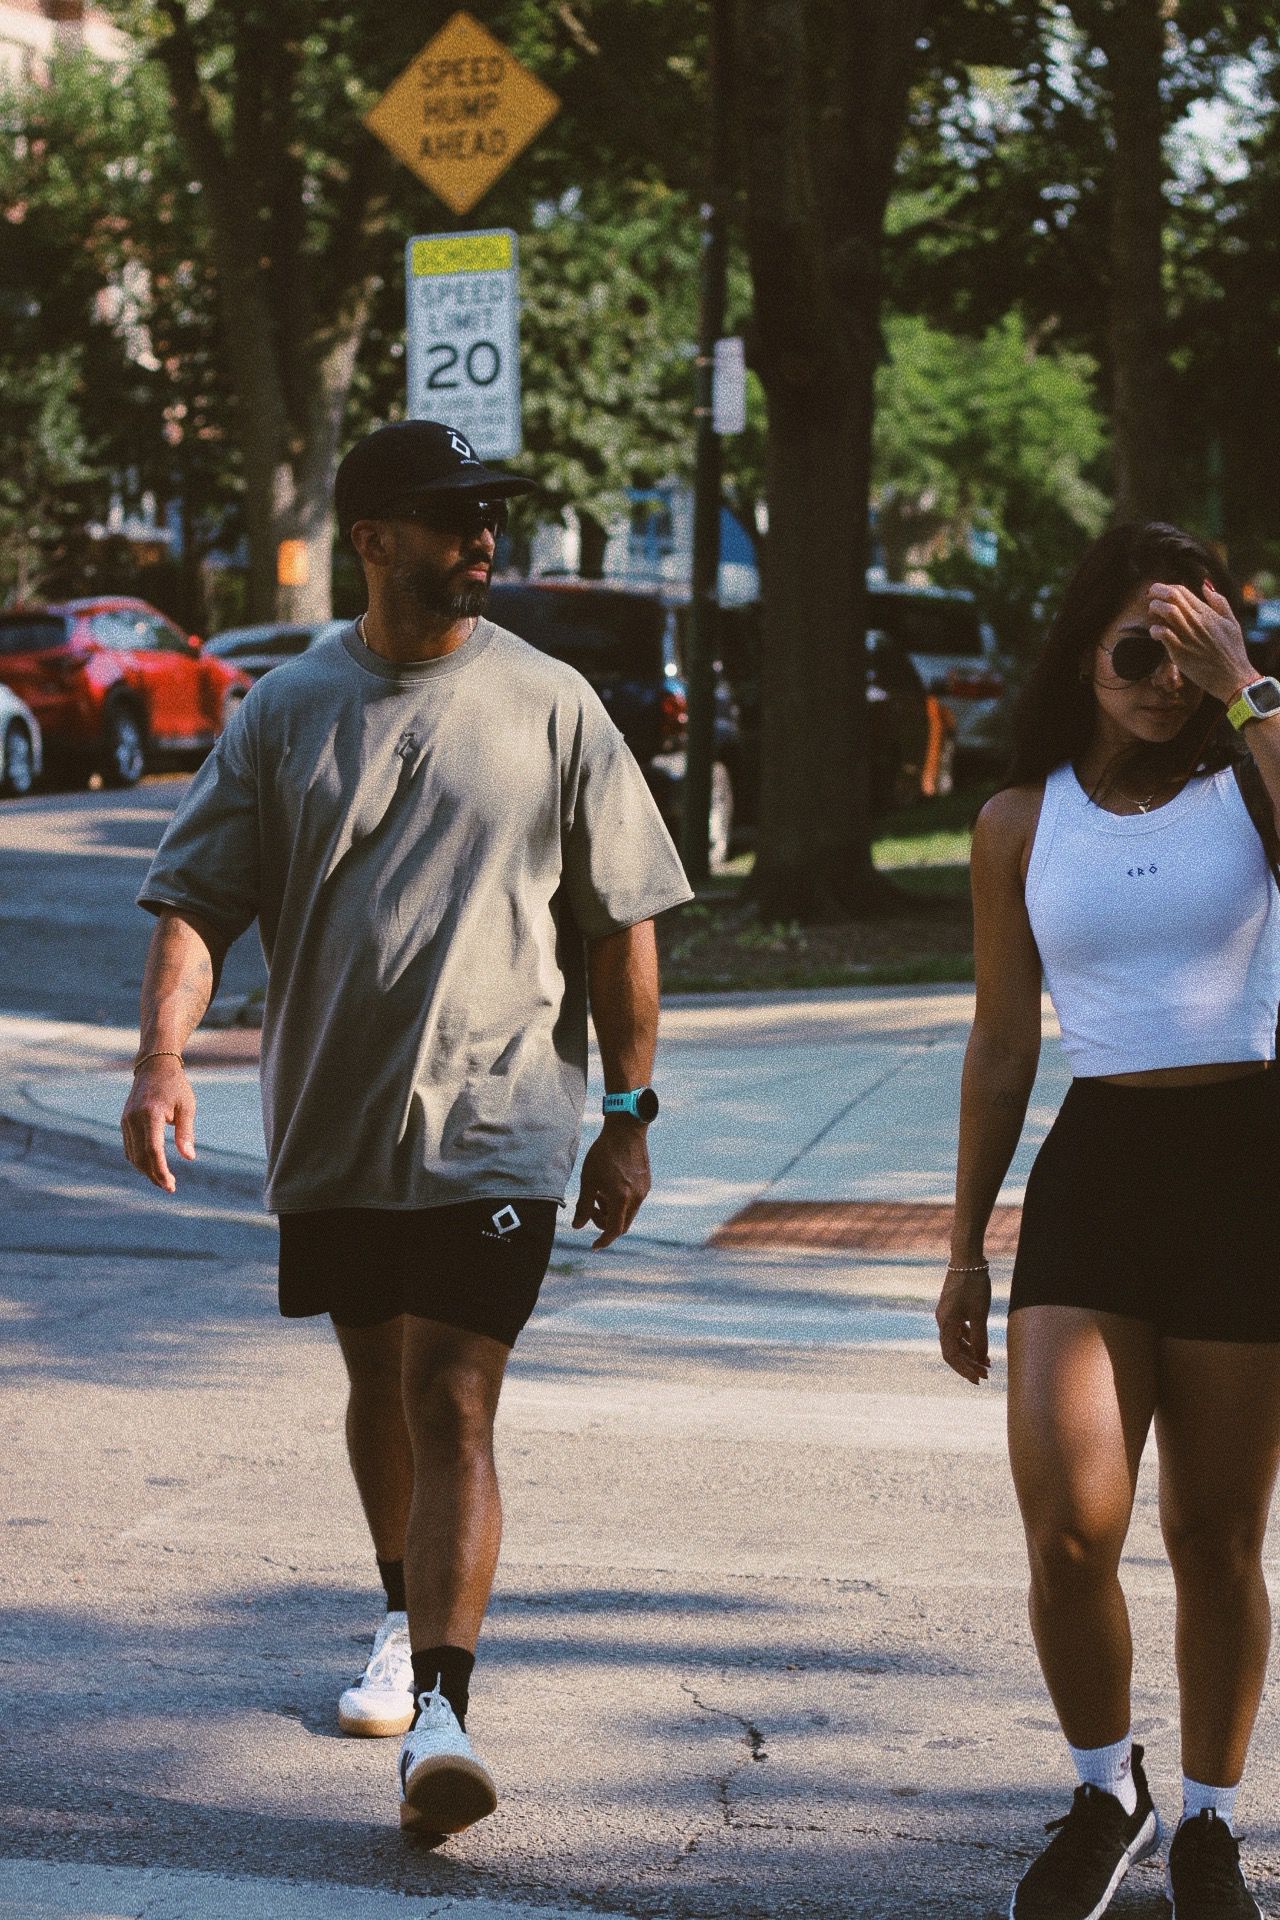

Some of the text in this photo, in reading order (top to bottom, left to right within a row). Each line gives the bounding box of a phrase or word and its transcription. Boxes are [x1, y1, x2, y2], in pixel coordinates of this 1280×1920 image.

[421, 55, 505, 88] SPEED
[424, 91, 500, 124] HUMP
[419, 127, 508, 160] AHEAD
[420, 279, 504, 307] SPEED
[428, 306, 494, 335] LIMIT
[426, 340, 501, 389] 20
